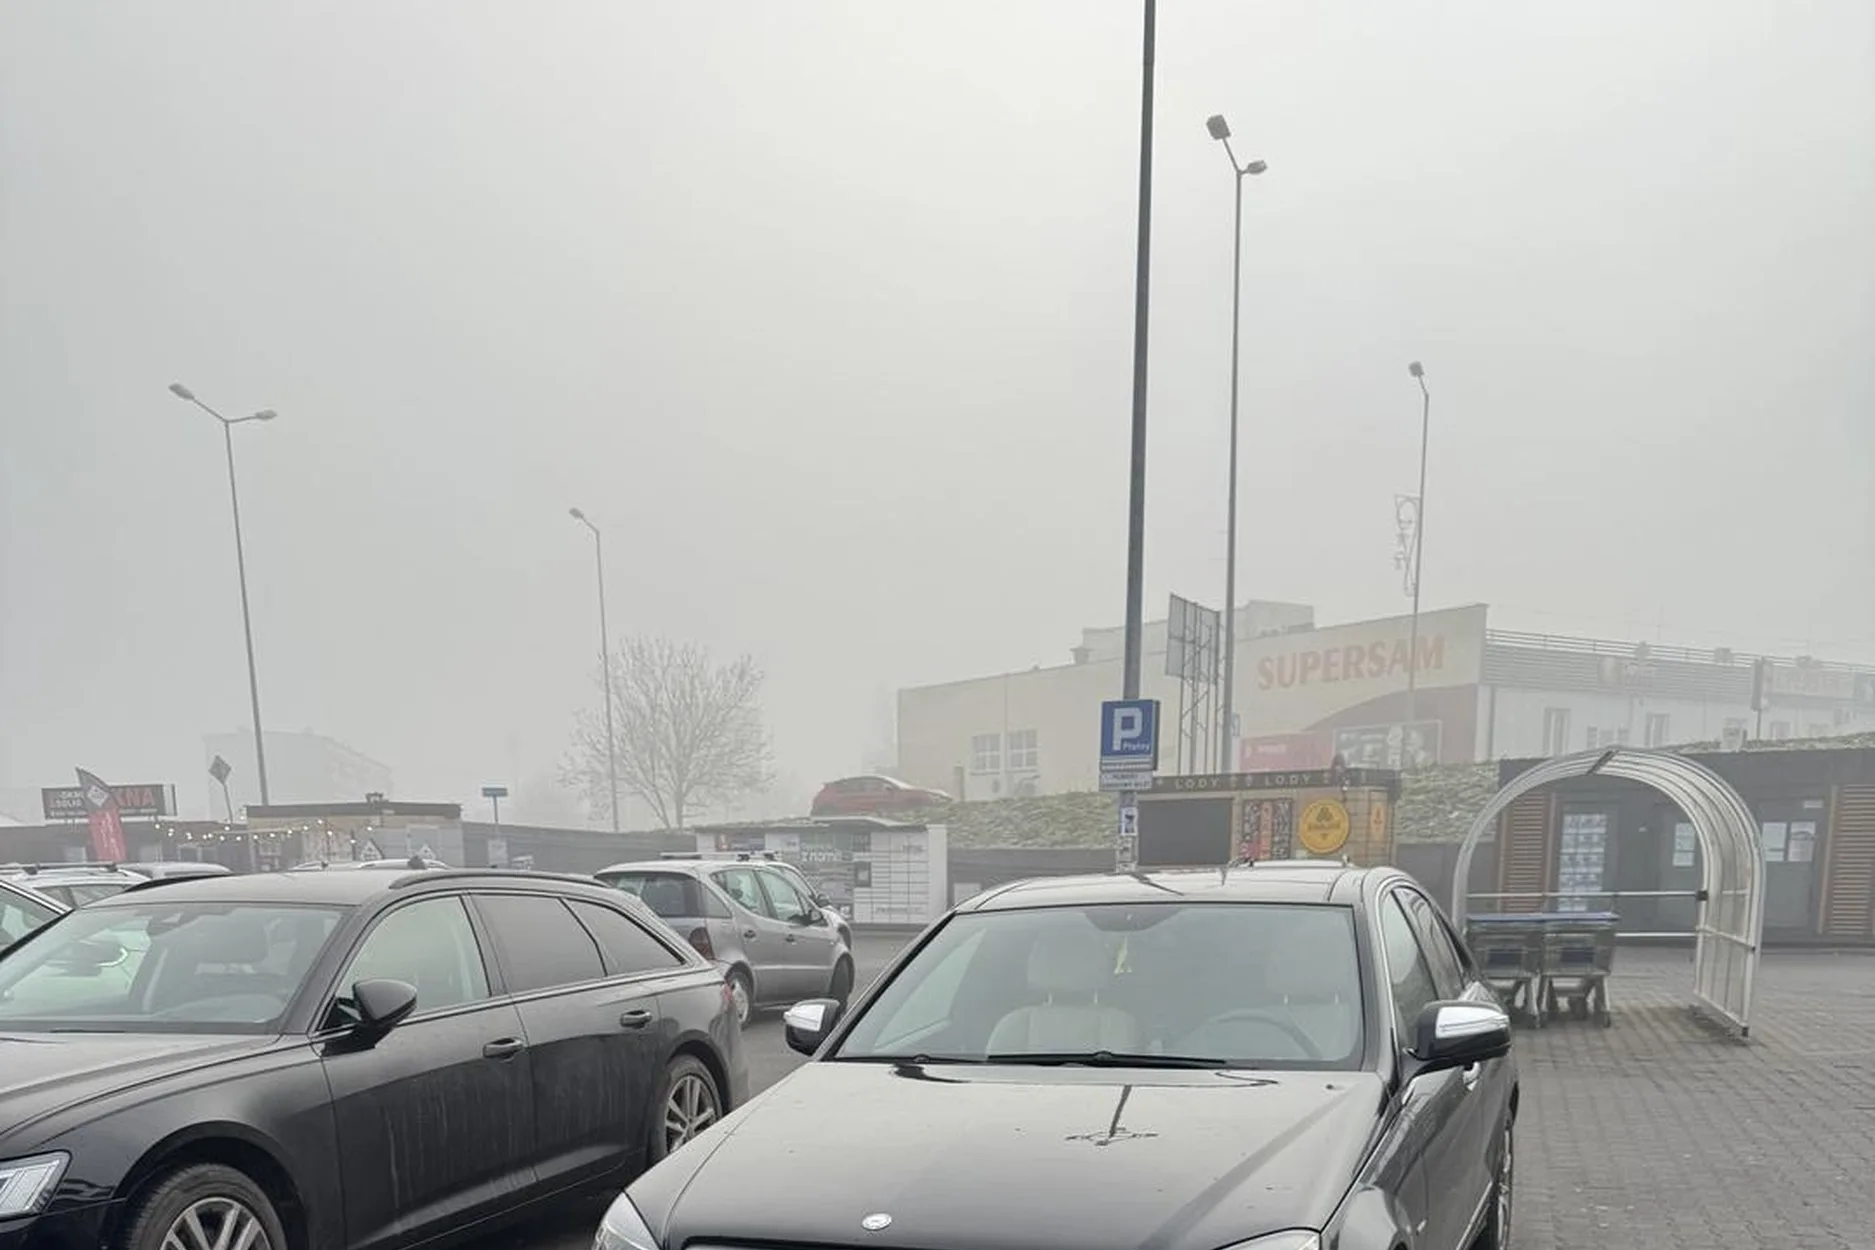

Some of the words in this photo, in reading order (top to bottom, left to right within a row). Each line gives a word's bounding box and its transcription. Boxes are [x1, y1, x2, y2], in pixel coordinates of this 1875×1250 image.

[1257, 634, 1445, 691] SUPERSAM
[1112, 707, 1143, 751] P
[1175, 777, 1220, 790] LODY
[1264, 773, 1311, 786] LODY
